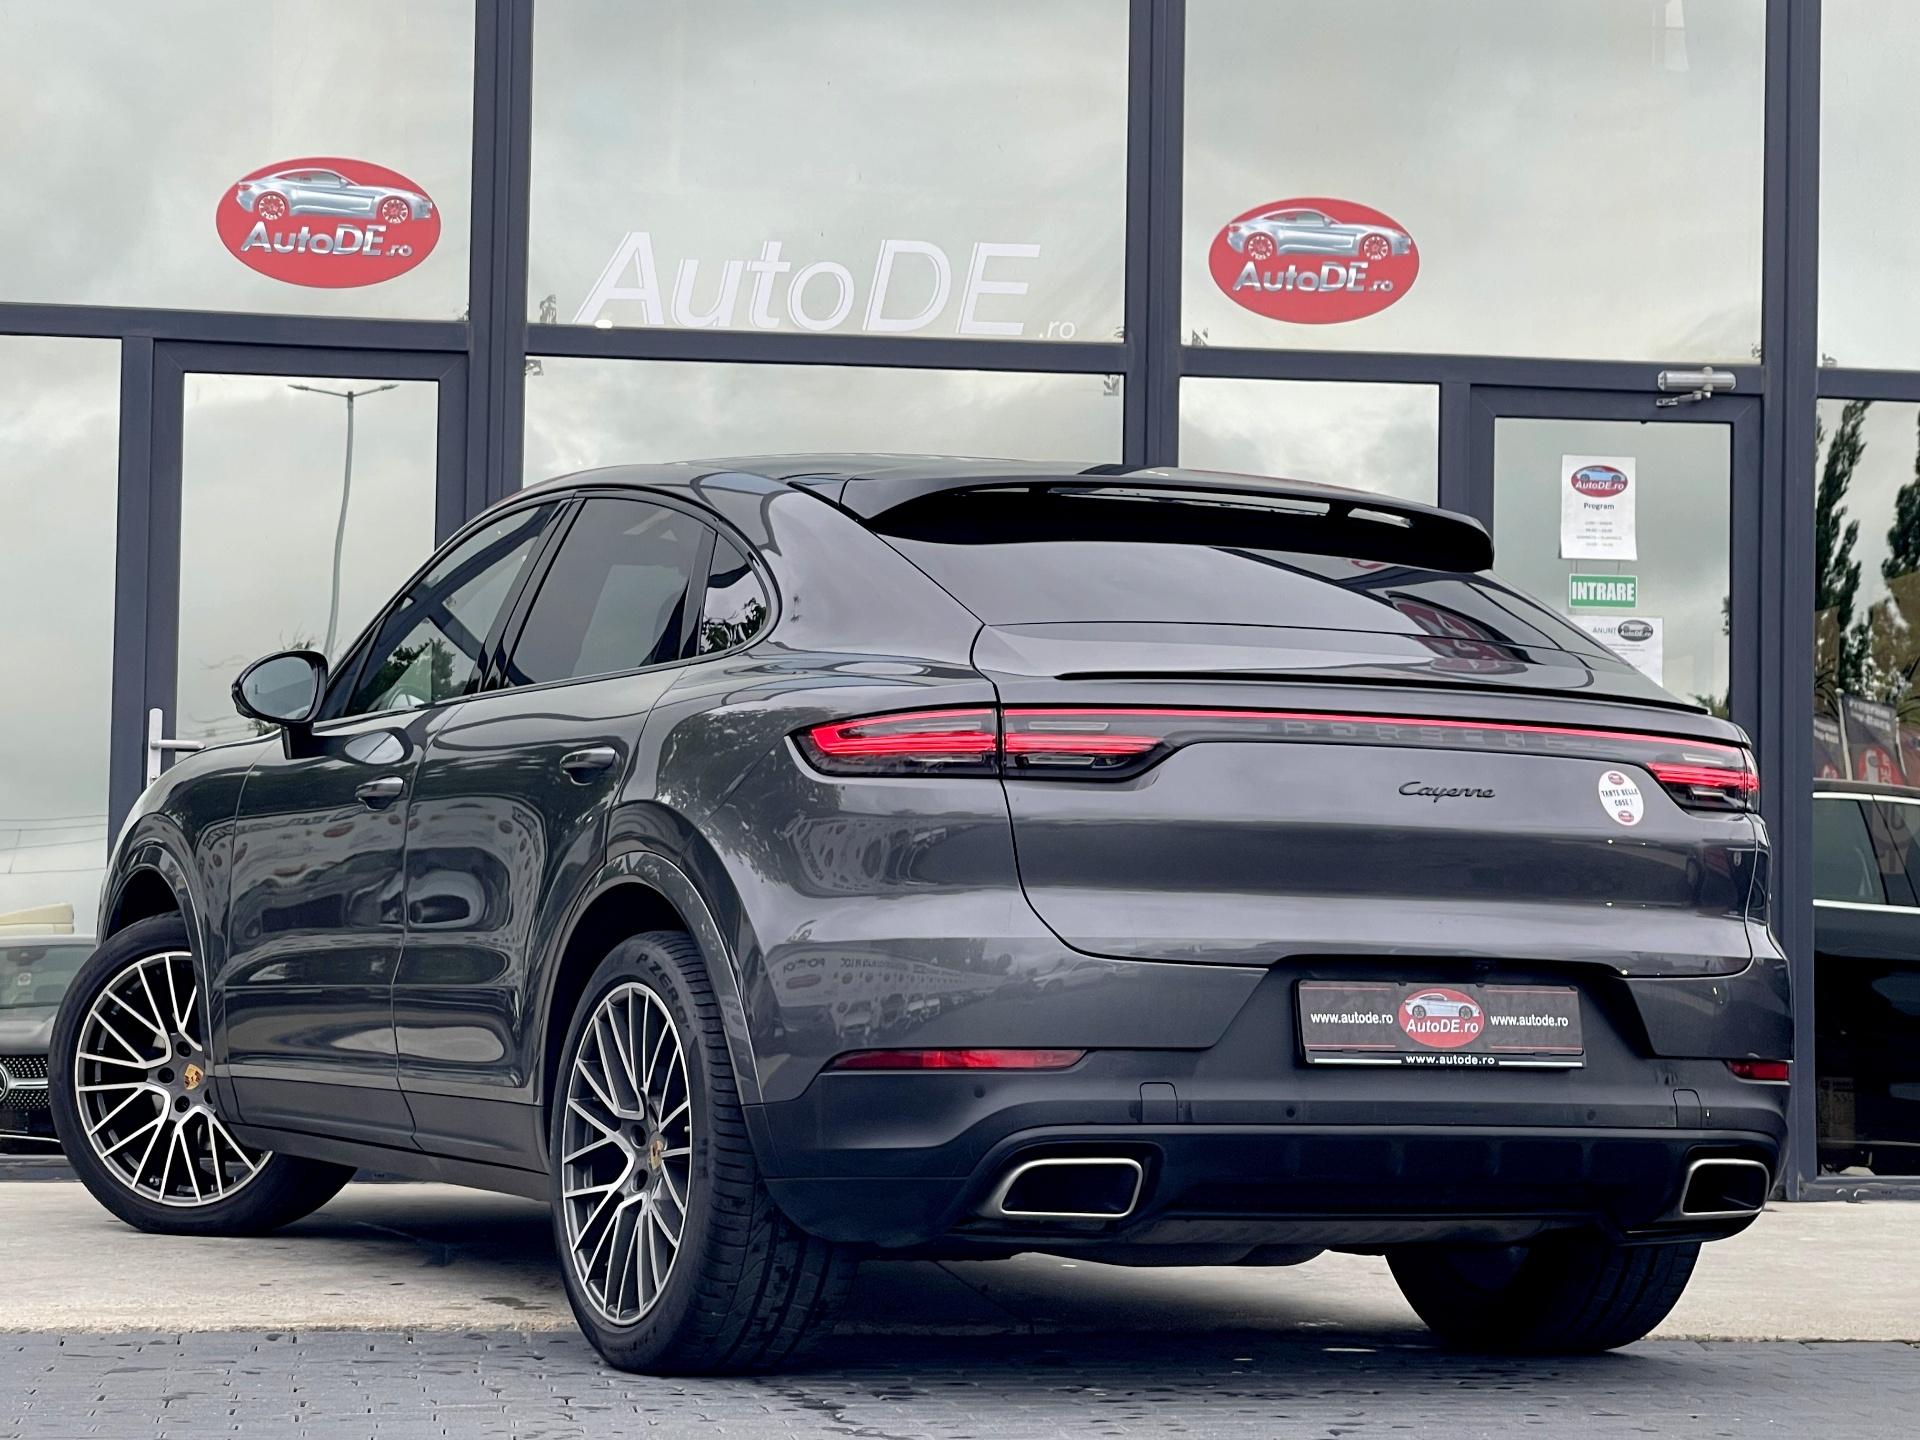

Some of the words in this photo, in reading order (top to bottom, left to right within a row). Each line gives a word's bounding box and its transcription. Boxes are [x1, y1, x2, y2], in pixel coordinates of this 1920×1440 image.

[1583, 502, 1615, 511] Program
[1571, 581, 1635, 602] INTRARE
[1398, 781, 1496, 803] Cayenne
[1310, 1010, 1394, 1025] www.autode.ro
[1490, 1013, 1569, 1028] www.autode.ro
[1405, 1018, 1480, 1034] AutoDE.ro
[1405, 1053, 1496, 1066] www.autode.ro
